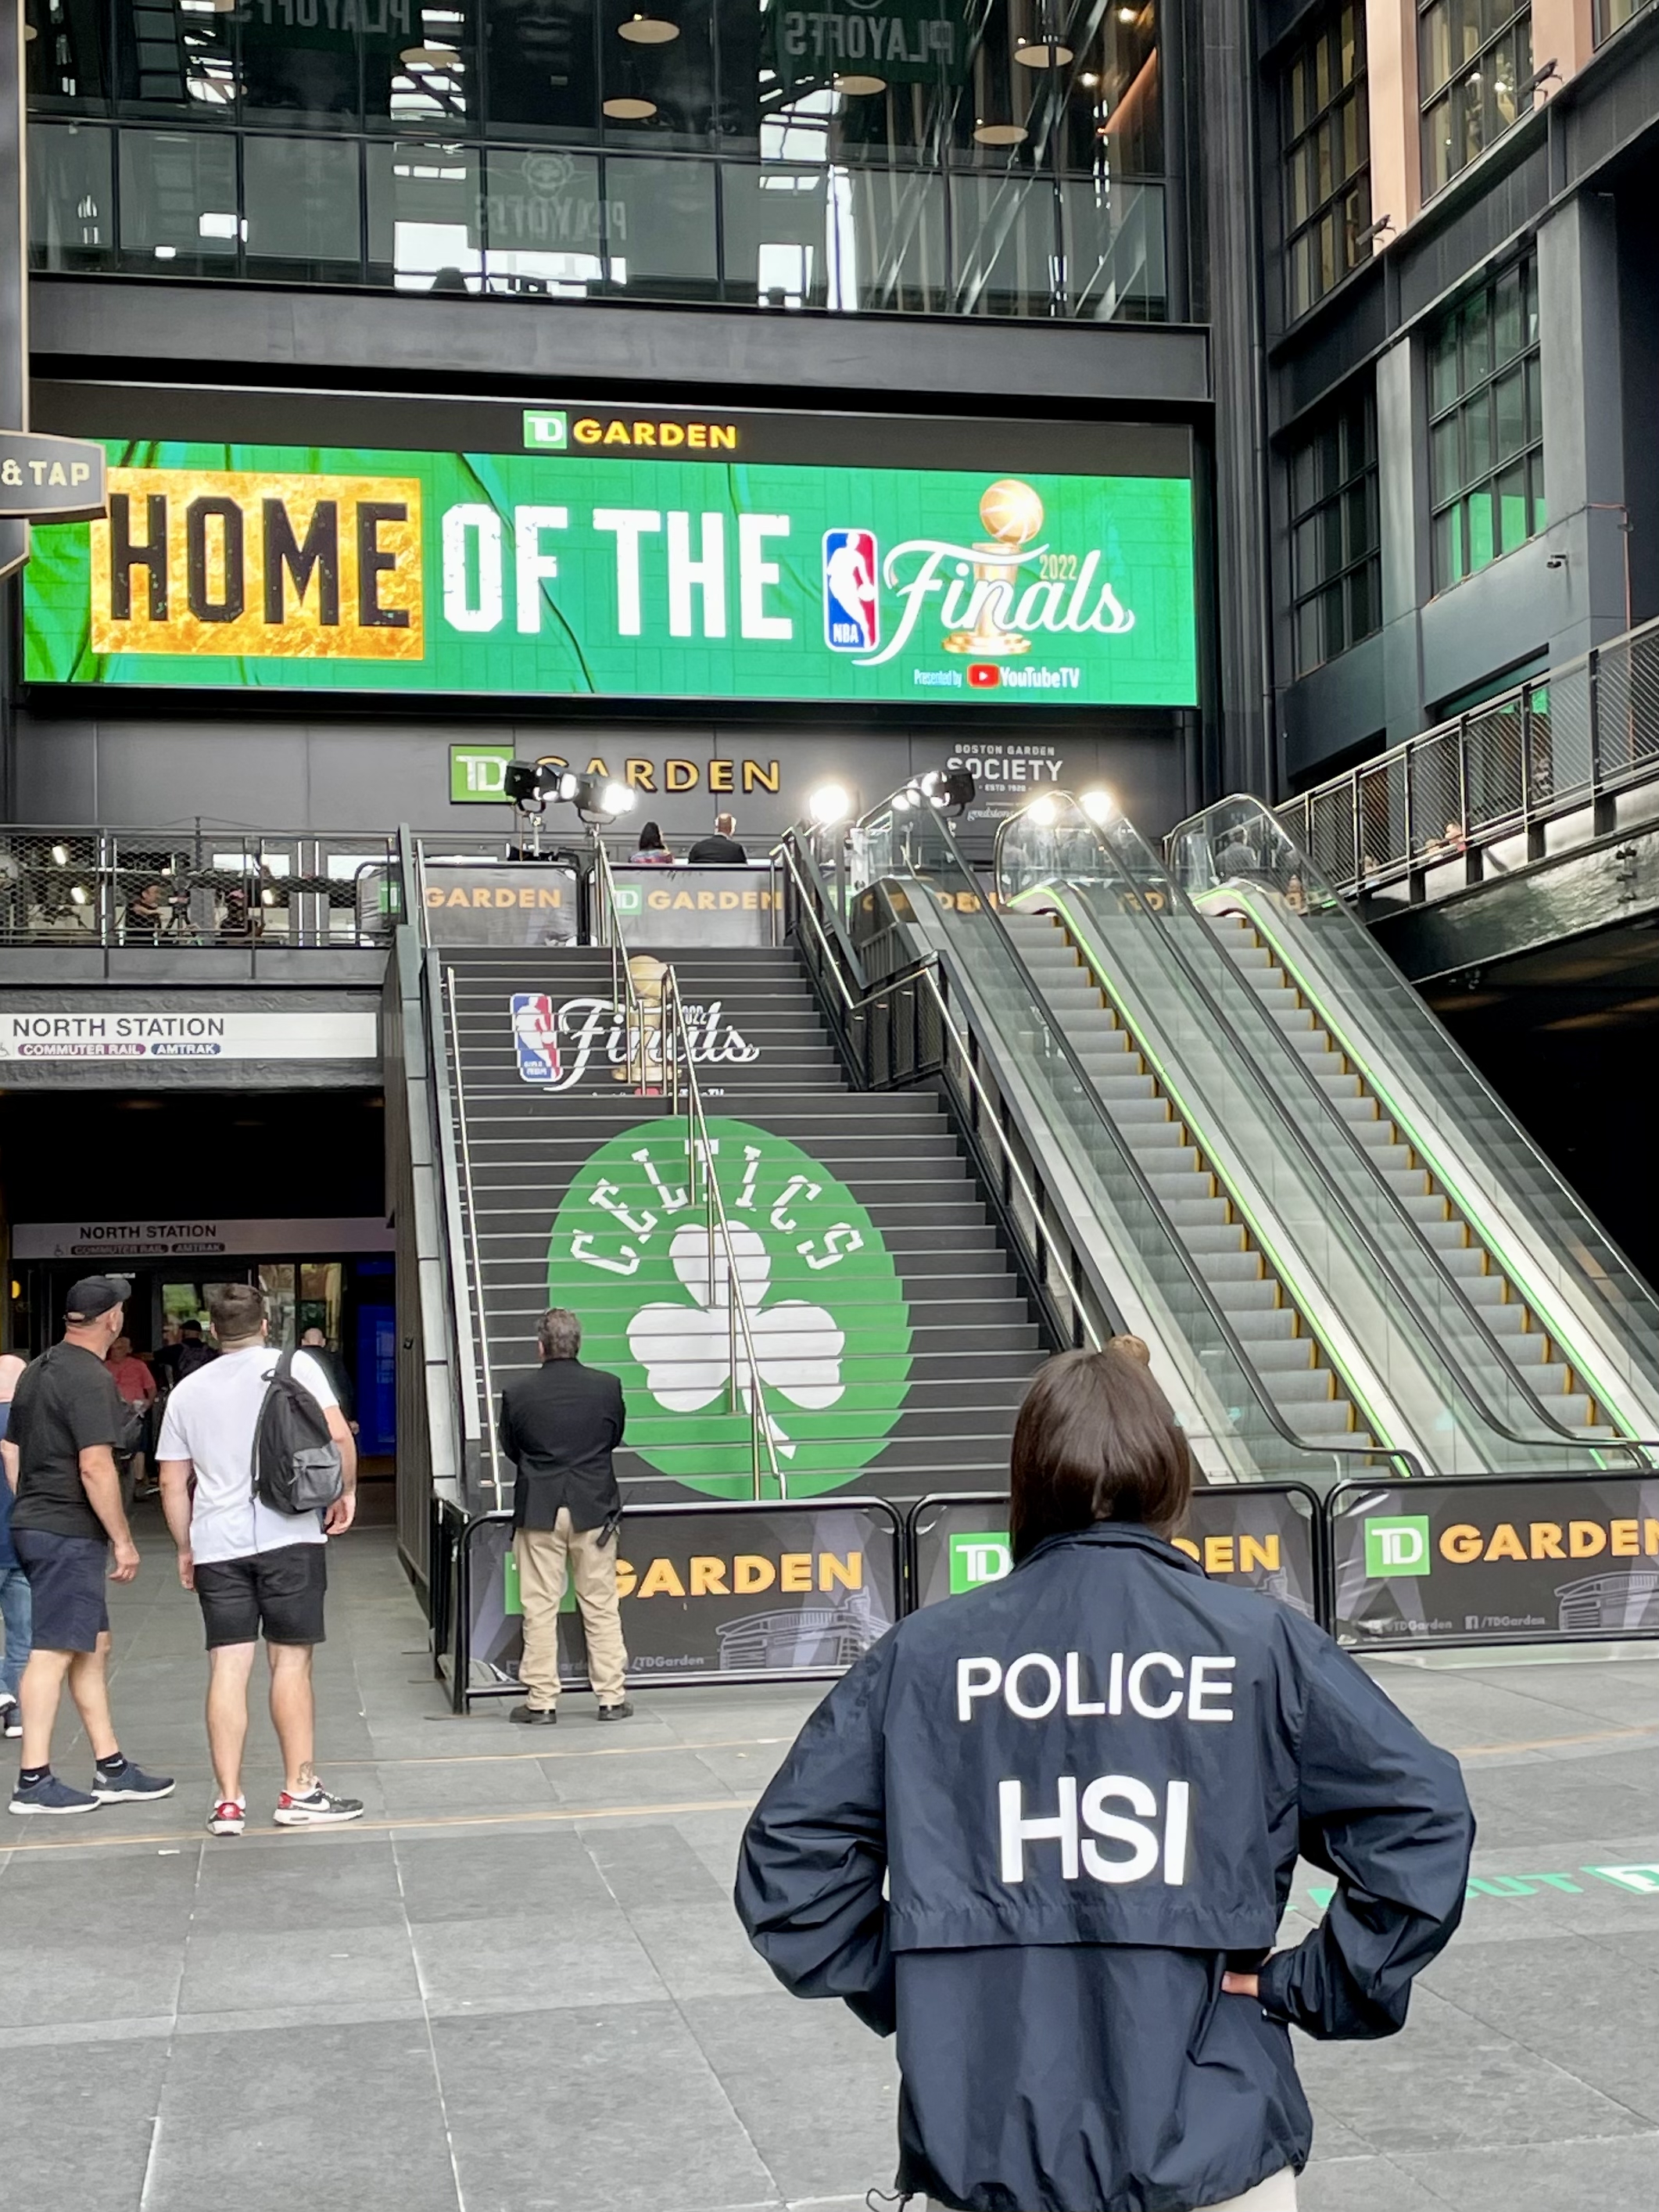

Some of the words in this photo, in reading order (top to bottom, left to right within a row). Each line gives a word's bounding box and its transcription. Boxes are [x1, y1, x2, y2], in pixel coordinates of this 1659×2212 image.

[528, 417, 564, 442] TD
[573, 418, 737, 450] GARDEN
[1, 458, 23, 486] &
[28, 461, 90, 486] TAP
[108, 493, 411, 628] HOME
[442, 504, 568, 634] OF
[593, 508, 793, 640] THE
[1039, 554, 1078, 581] 2022
[851, 540, 1135, 665] Finals
[833, 623, 860, 644] NBA
[914, 669, 953, 687] Presented
[953, 670, 962, 688] by
[955, 744, 1003, 755] BOSTON
[1007, 744, 1055, 756] GARDEN
[456, 755, 507, 791] TD
[947, 757, 1063, 781] SOCIETY
[425, 887, 561, 909] GARDEN
[647, 890, 782, 910] GARDEN
[13, 1018, 106, 1037] NORTH
[116, 1018, 224, 1037] STATION
[681, 1005, 707, 1026] 022
[23, 1043, 107, 1056] COMMUTER
[108, 1043, 141, 1056] RAIL
[156, 1043, 215, 1055] AMTRAK
[570, 1138, 865, 1276] CELTICS
[80, 1226, 141, 1239] NORTH
[146, 1224, 217, 1239] STATION
[1371, 1527, 1423, 1565] TD
[955, 1543, 1014, 1582] TD
[957, 1651, 1236, 1721] POLICE
[998, 1774, 1189, 1885] HSI
